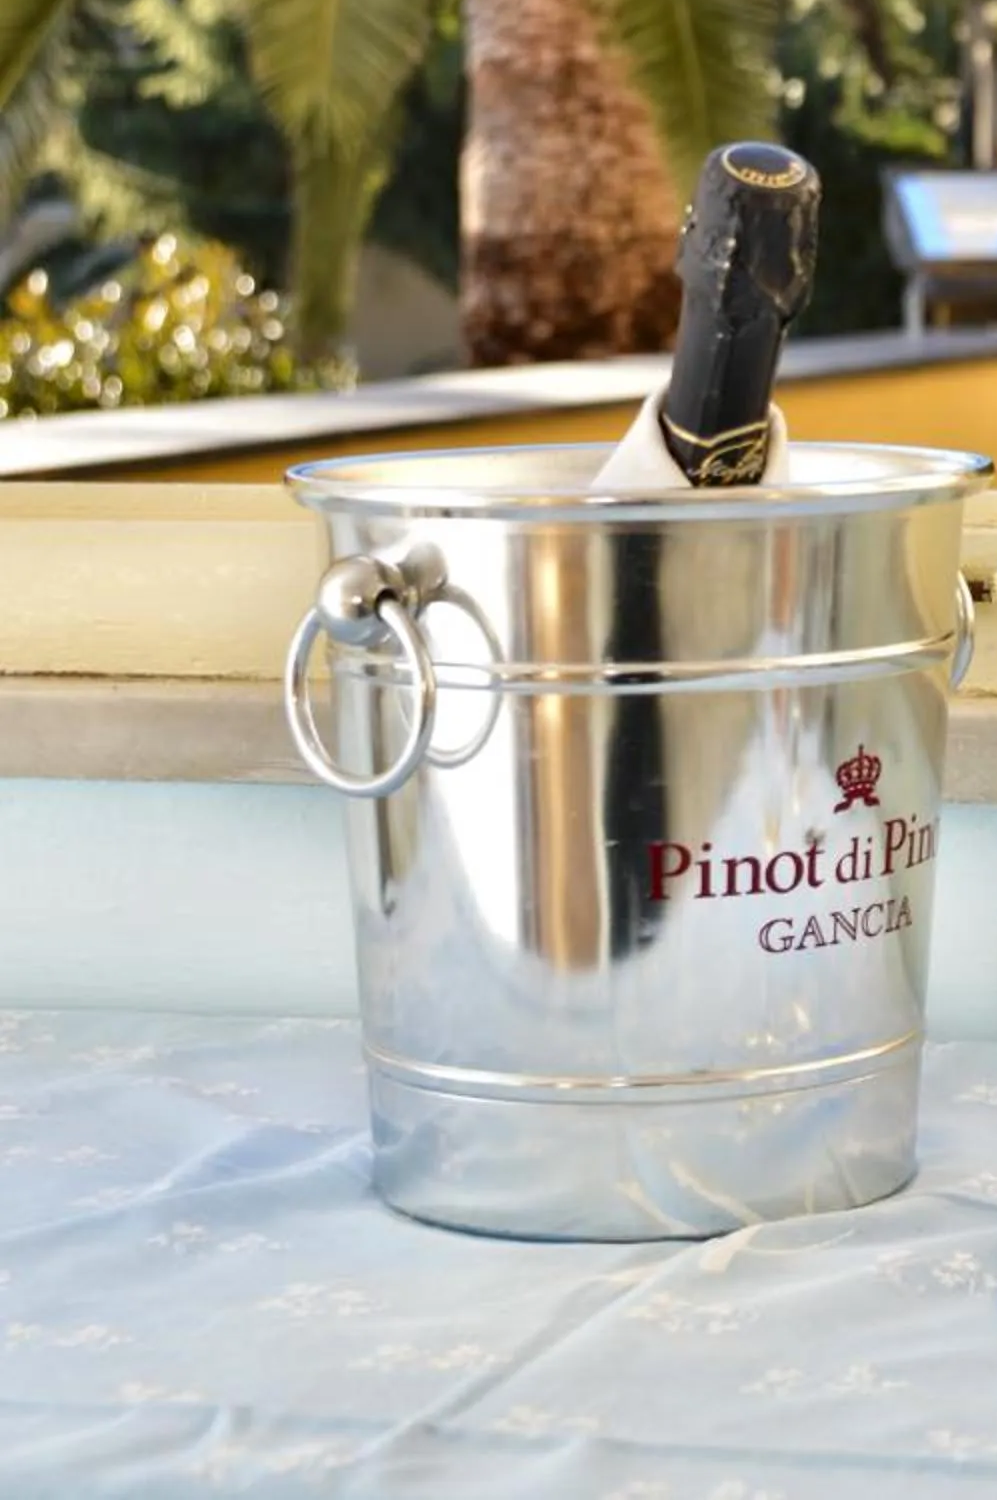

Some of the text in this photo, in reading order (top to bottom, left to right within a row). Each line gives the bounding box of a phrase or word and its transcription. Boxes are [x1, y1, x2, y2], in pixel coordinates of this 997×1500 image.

[647, 840, 825, 902] Pinot
[835, 836, 873, 884] di
[759, 896, 913, 953] GANCIA
